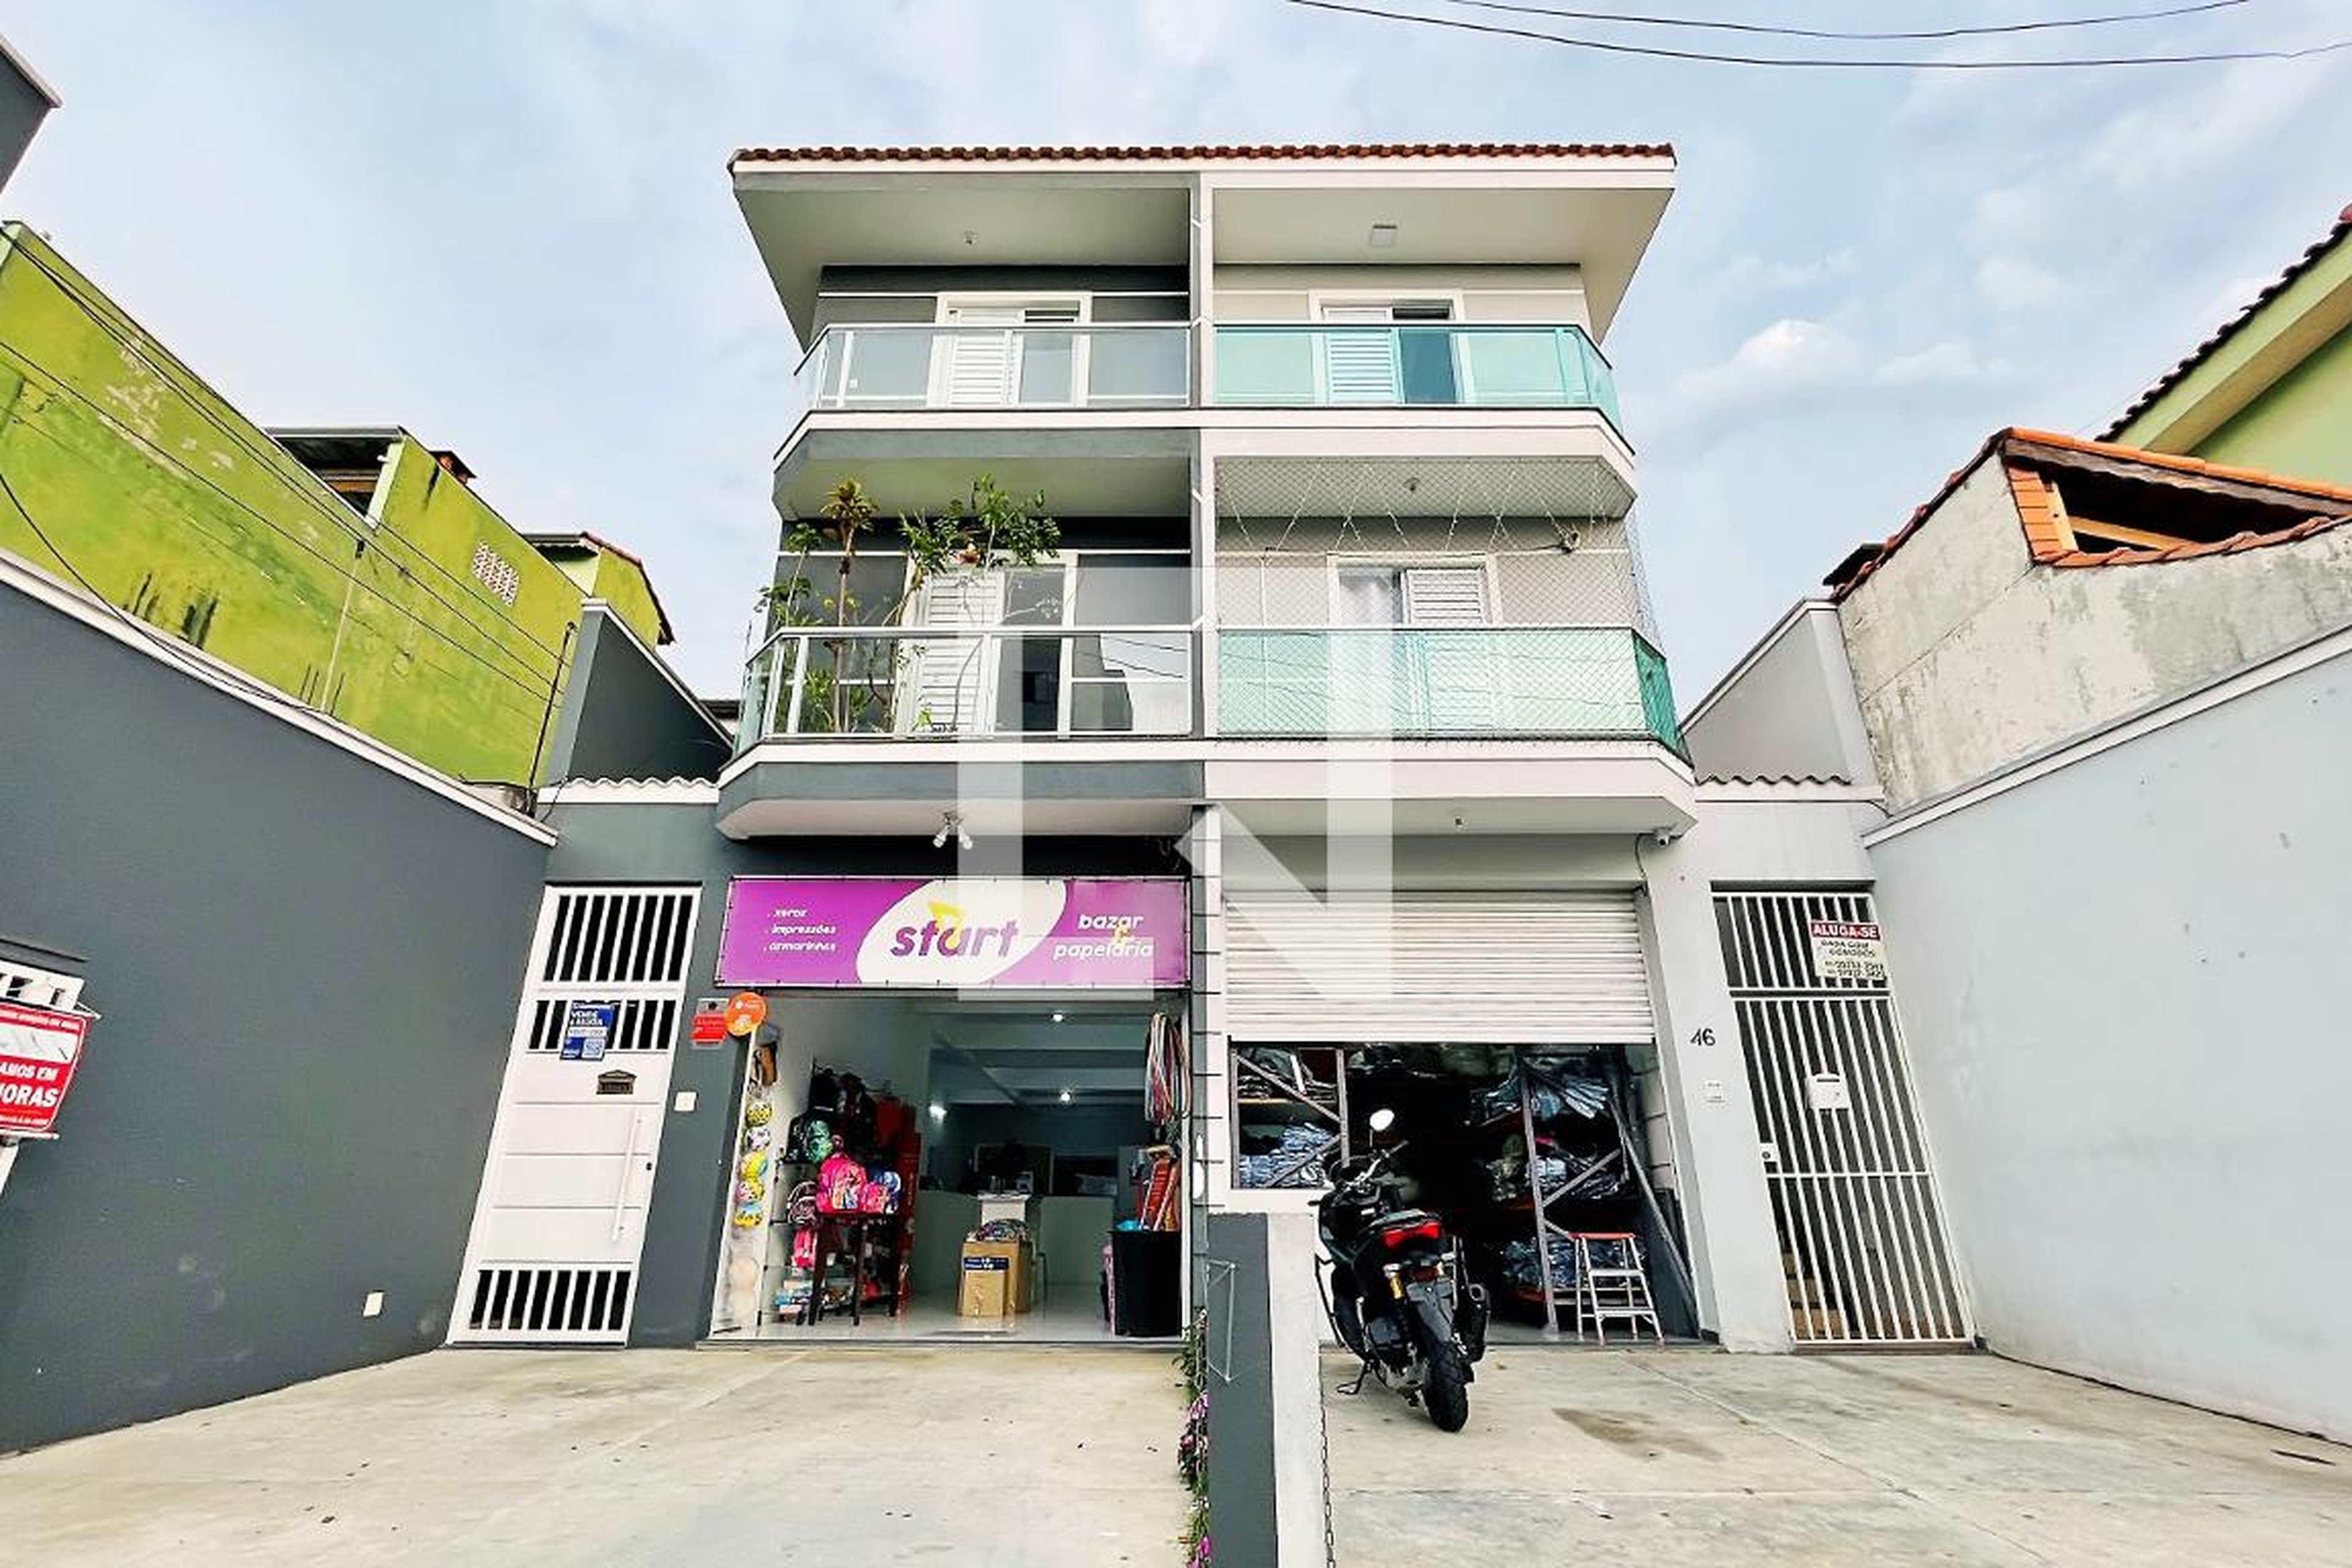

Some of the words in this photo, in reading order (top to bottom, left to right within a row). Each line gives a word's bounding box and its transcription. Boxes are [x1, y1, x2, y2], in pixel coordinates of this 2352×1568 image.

[1078, 914, 1144, 929] bazar
[1813, 923, 1878, 938] ALUGA-SE
[890, 920, 1019, 957] start
[1053, 941, 1154, 960] papelaria
[36, 1067, 59, 1081] EM
